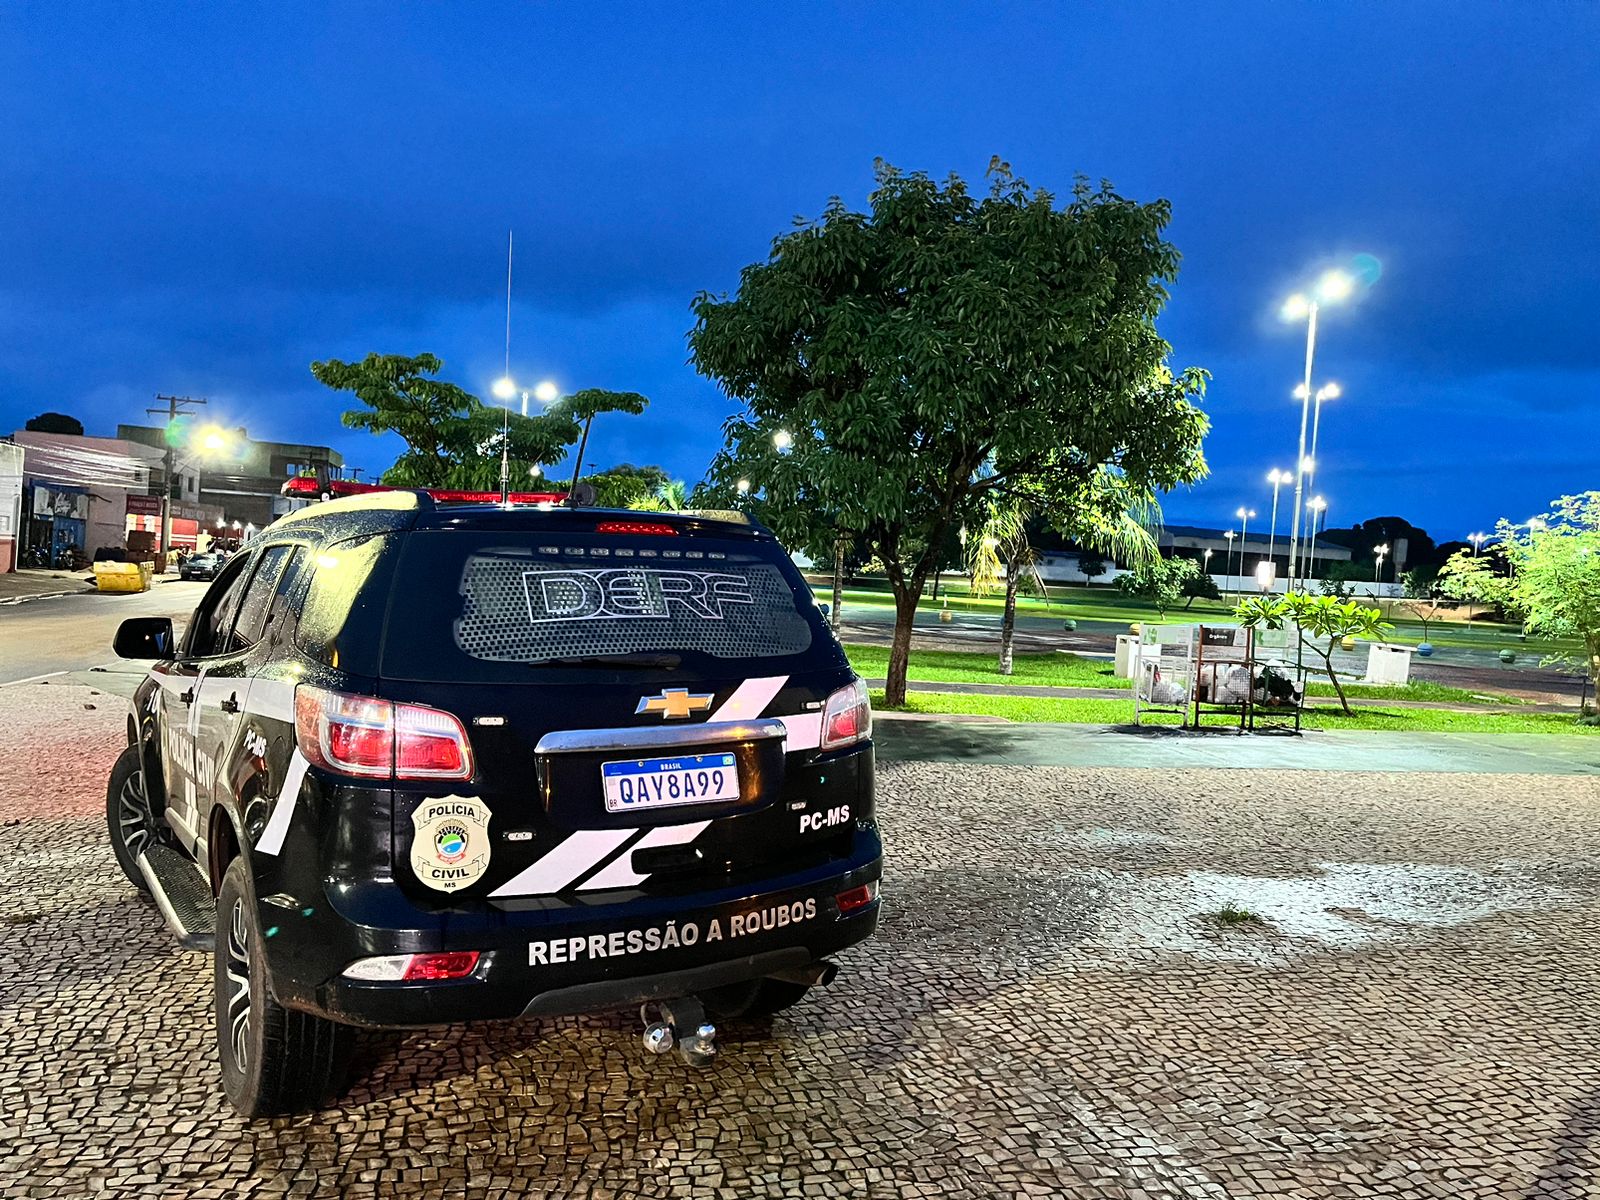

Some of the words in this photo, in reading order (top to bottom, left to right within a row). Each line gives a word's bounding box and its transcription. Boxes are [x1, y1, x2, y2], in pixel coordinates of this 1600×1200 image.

[522, 568, 754, 623] DERF
[243, 728, 267, 758] PC-MS
[660, 762, 682, 771] BRASIL
[619, 770, 724, 804] QAY8A99
[429, 803, 475, 818] POLÍCIA
[609, 799, 618, 808] BR
[800, 805, 849, 833] PC-MS
[432, 868, 469, 879] CIVIL
[528, 920, 699, 966] REPRESSÃO
[706, 919, 722, 942] A
[730, 898, 816, 938] ROUBOS
